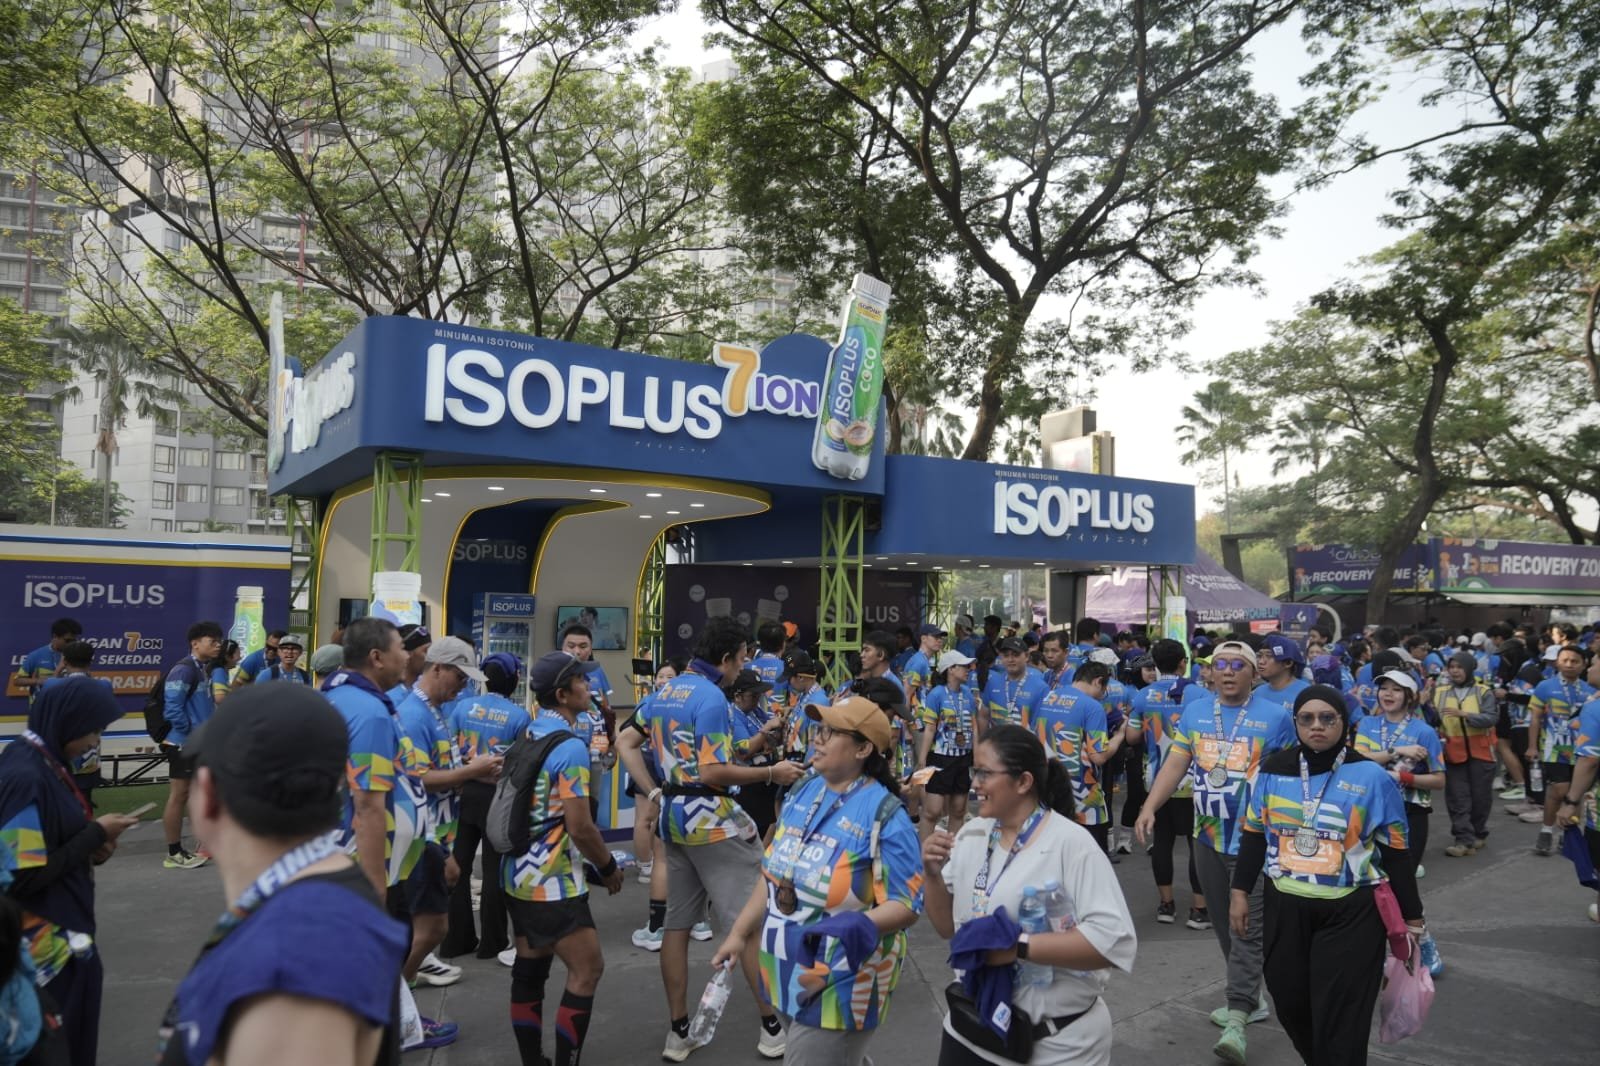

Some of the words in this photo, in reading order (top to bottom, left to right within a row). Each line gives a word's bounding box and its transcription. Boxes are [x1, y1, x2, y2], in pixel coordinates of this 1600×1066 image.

[434, 328, 484, 345] MINUMAN
[486, 336, 535, 353] ISOTONIK
[833, 336, 860, 424] ISOPLUS
[859, 347, 877, 393] COCO
[424, 343, 722, 440] ISOPLUS
[993, 481, 1155, 537] ISOPLUS
[454, 543, 528, 561] SOPLUS
[1312, 568, 1375, 583] RECOVERY
[1393, 567, 1412, 580] NE
[1501, 553, 1580, 577] RECOVERY
[1579, 557, 1600, 578] ZO
[23, 581, 165, 609] ISOPLUS
[492, 602, 531, 613] ISOPLUS
[250, 621, 260, 646] COCO
[98, 654, 162, 666] SEKEDAR
